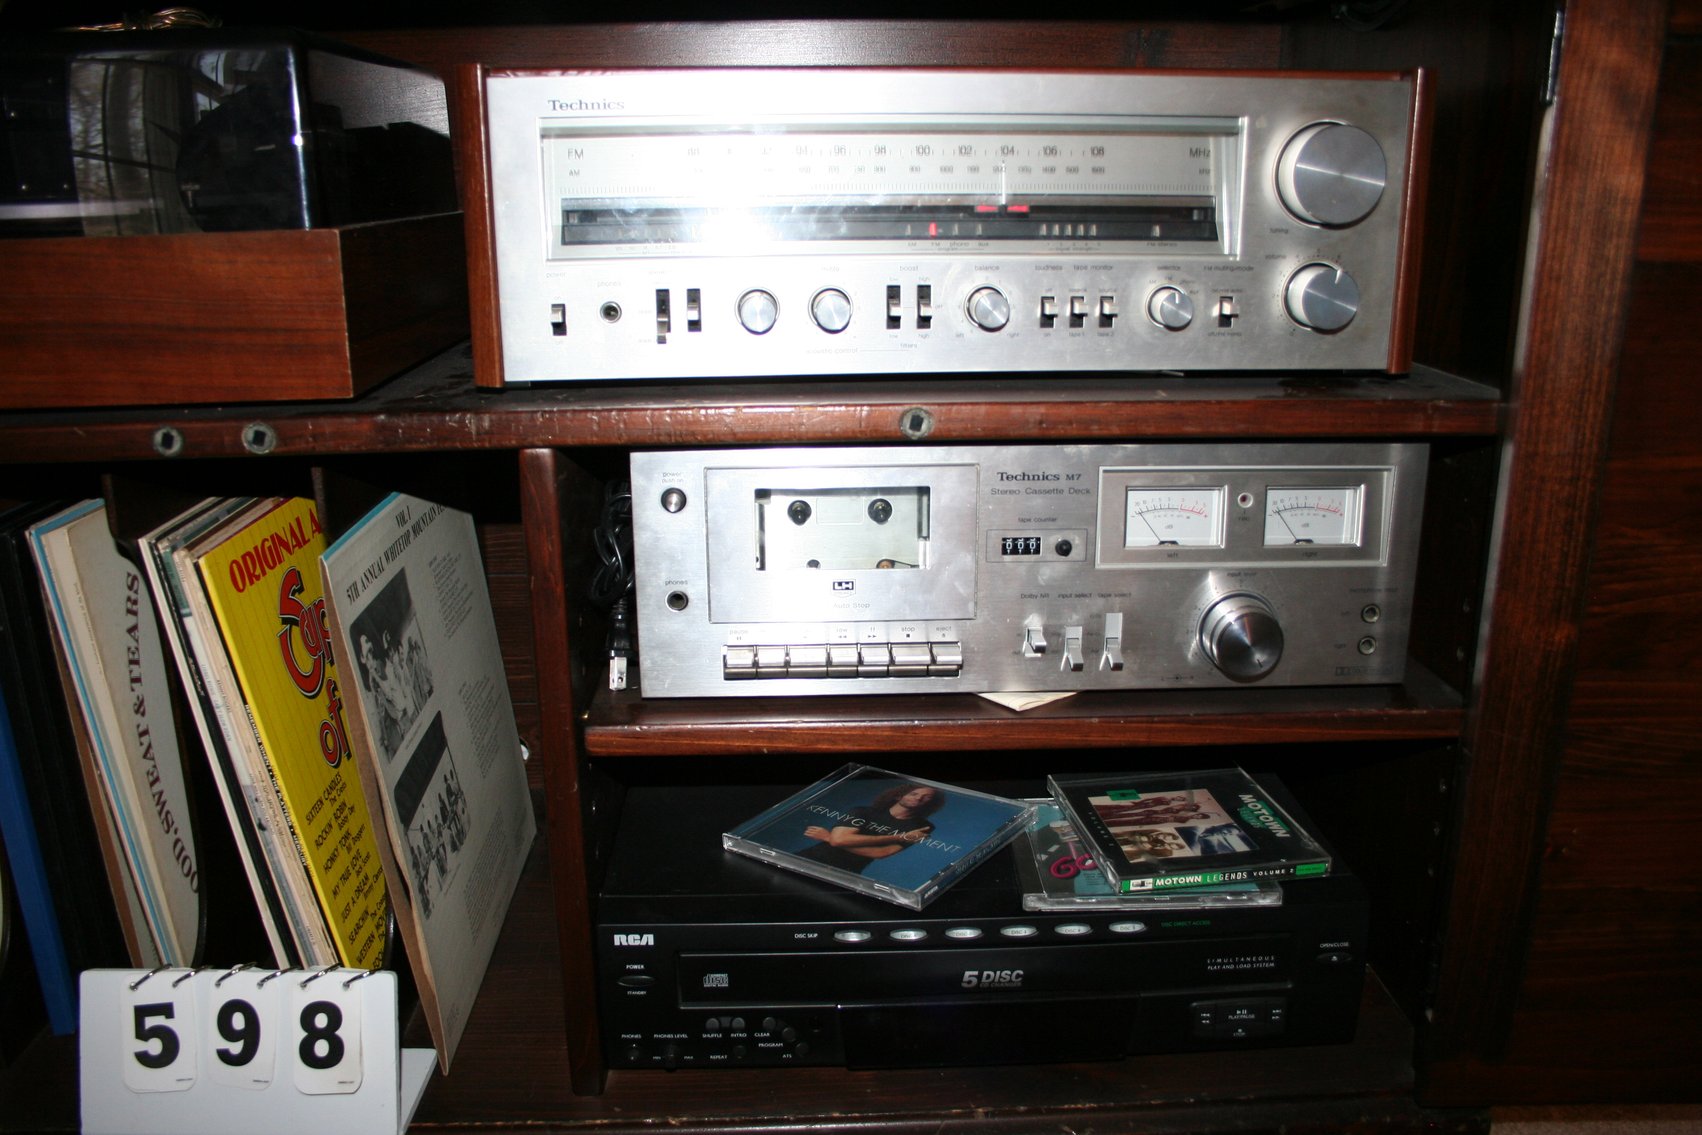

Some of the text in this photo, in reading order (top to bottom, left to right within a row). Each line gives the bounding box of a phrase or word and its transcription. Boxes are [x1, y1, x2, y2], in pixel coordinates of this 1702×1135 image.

[548, 98, 625, 112] Technics
[567, 148, 584, 159] FM
[874, 145, 886, 155] 98
[915, 145, 931, 156] 100
[958, 145, 973, 156] 102
[1001, 145, 1015, 156] 104
[1043, 146, 1058, 156] 106
[1090, 146, 1105, 157] 108
[1189, 147, 1211, 158] MHz
[997, 471, 1082, 481] Technics M7
[990, 487, 1092, 496] Stereo Cassette Deck
[229, 515, 310, 593] ORIGINAL
[309, 508, 322, 536] A
[360, 556, 385, 592] ANNUAL
[853, 602, 870, 610] Stop
[126, 571, 141, 687] TEARS
[132, 694, 147, 718] &
[320, 677, 352, 769] of
[137, 723, 175, 836] SWEAT
[306, 771, 342, 825] SIXTEEN CANDLES
[333, 800, 347, 822] ROBIN
[806, 804, 962, 854] KENNY G THE MOMENT
[1238, 794, 1291, 838] MOTOWN
[323, 828, 352, 874] HONKY TONK
[331, 848, 362, 899] MY TRUE LOVE
[354, 872, 370, 900] DREAM
[1155, 875, 1202, 887] MOTOWN
[1206, 871, 1248, 883] LEGENDS
[1253, 868, 1286, 876] VOLUME
[356, 930, 376, 965] WESTERN
[614, 933, 655, 946] RCA
[1207, 955, 1275, 964] SIMULTANEOUS
[961, 970, 1024, 988] 5 DISC
